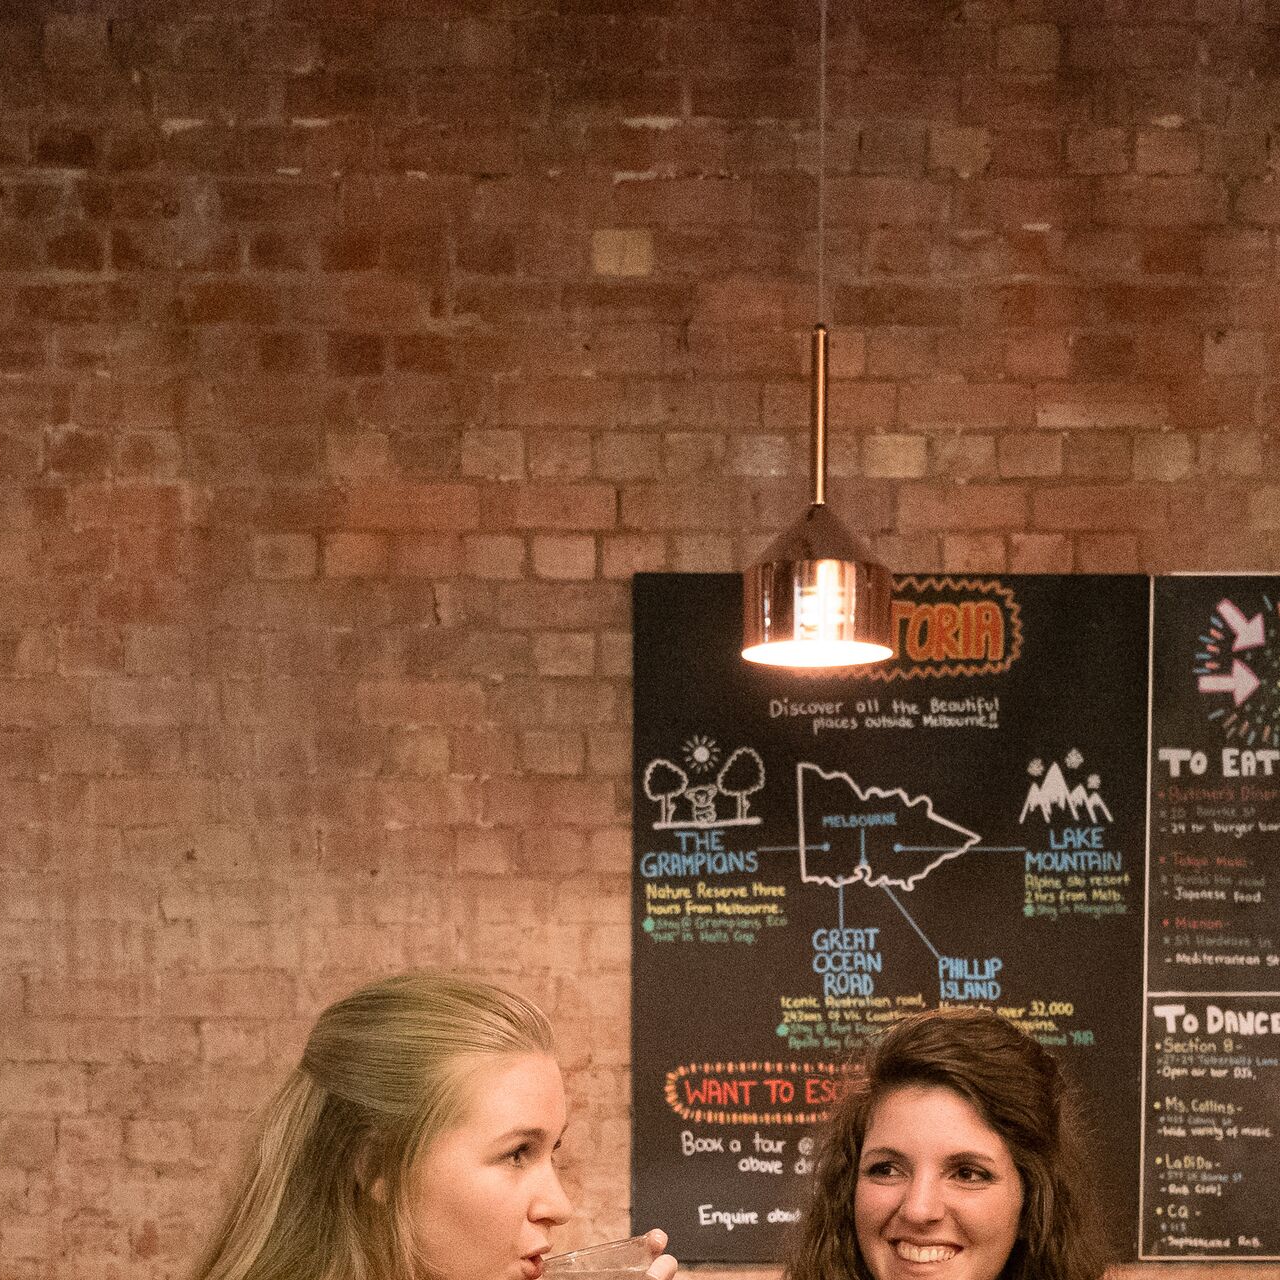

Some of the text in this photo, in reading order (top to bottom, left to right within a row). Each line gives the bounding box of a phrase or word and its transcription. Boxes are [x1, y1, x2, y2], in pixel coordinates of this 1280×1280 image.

[892, 600, 1006, 661] TORIA
[769, 697, 1001, 719] Discover all the Beautiful
[813, 715, 859, 734] places
[864, 714, 914, 730] outside
[823, 812, 898, 828] MELBOURNE
[674, 831, 726, 852] THE
[1049, 827, 1106, 850] LAKE
[1024, 850, 1123, 873] MOUNTAIN
[645, 883, 692, 899] Nature
[696, 881, 749, 899] Reserve
[811, 928, 880, 951] GREAT
[812, 952, 883, 974] OCEAN
[938, 956, 1004, 981] PHILLIP
[823, 973, 874, 997] ROAD
[939, 980, 1001, 1001] ISLAND
[1163, 1036, 1218, 1054] Section
[683, 1079, 758, 1106] WANT
[763, 1079, 795, 1104] TO
[681, 1130, 724, 1156] Book
[729, 1139, 741, 1153] a
[753, 1132, 787, 1154] tour
[737, 1157, 784, 1174] above
[697, 1203, 759, 1231] Enquire
